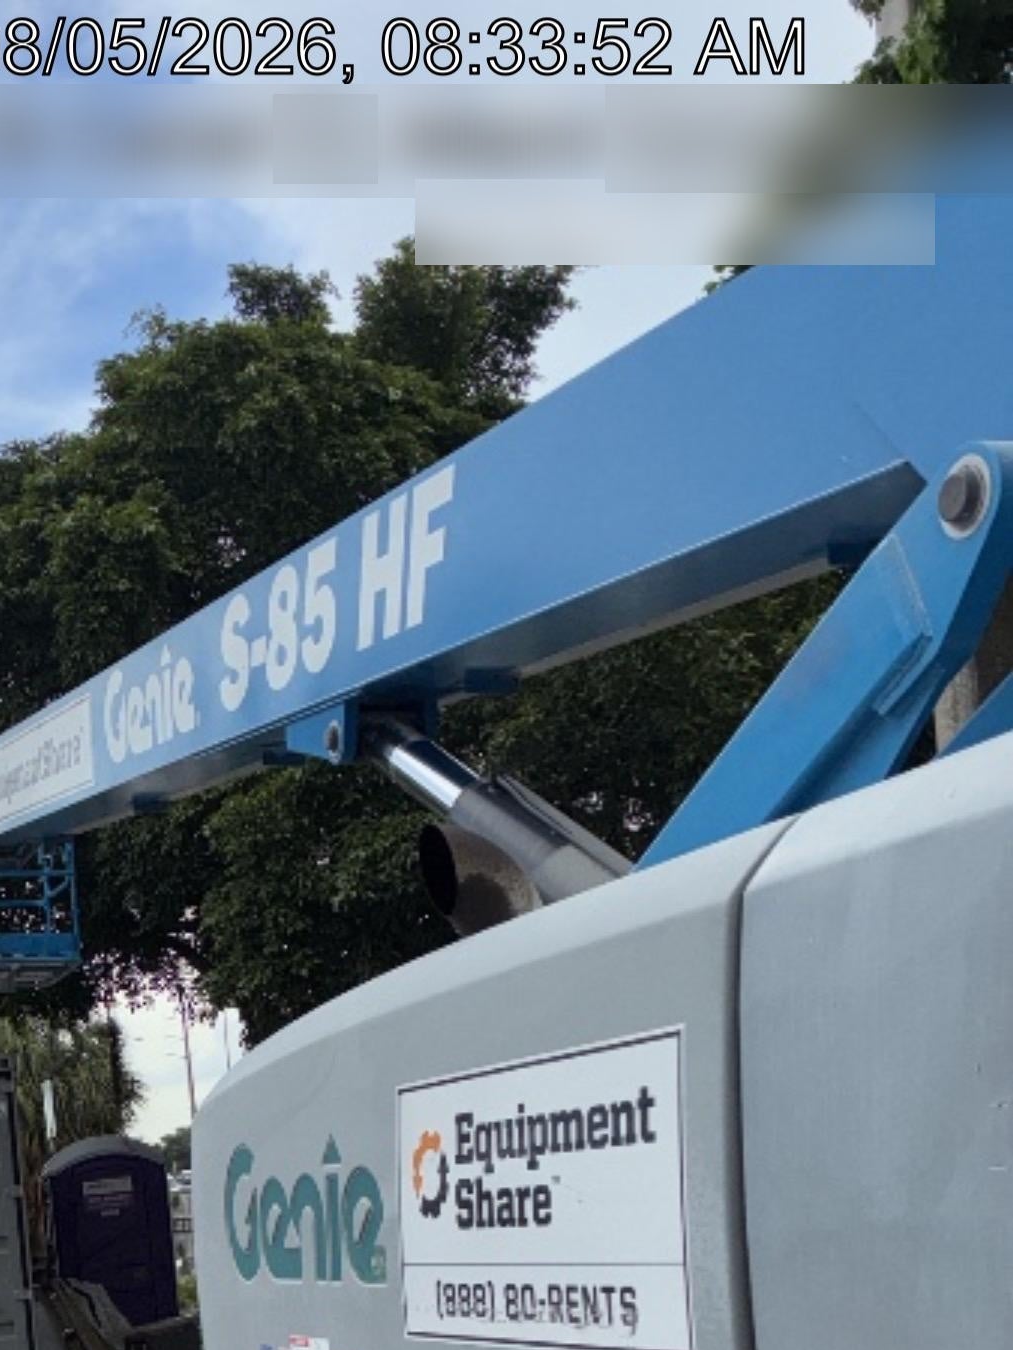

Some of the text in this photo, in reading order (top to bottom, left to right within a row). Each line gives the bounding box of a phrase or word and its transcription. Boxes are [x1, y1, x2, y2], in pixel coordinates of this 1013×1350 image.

[103, 463, 457, 764] Genie S-85 HF
[454, 1085, 657, 1171] Equipment
[223, 1133, 385, 1285] Genie
[454, 1176, 553, 1231] Share
[435, 1279, 496, 1323] (888)
